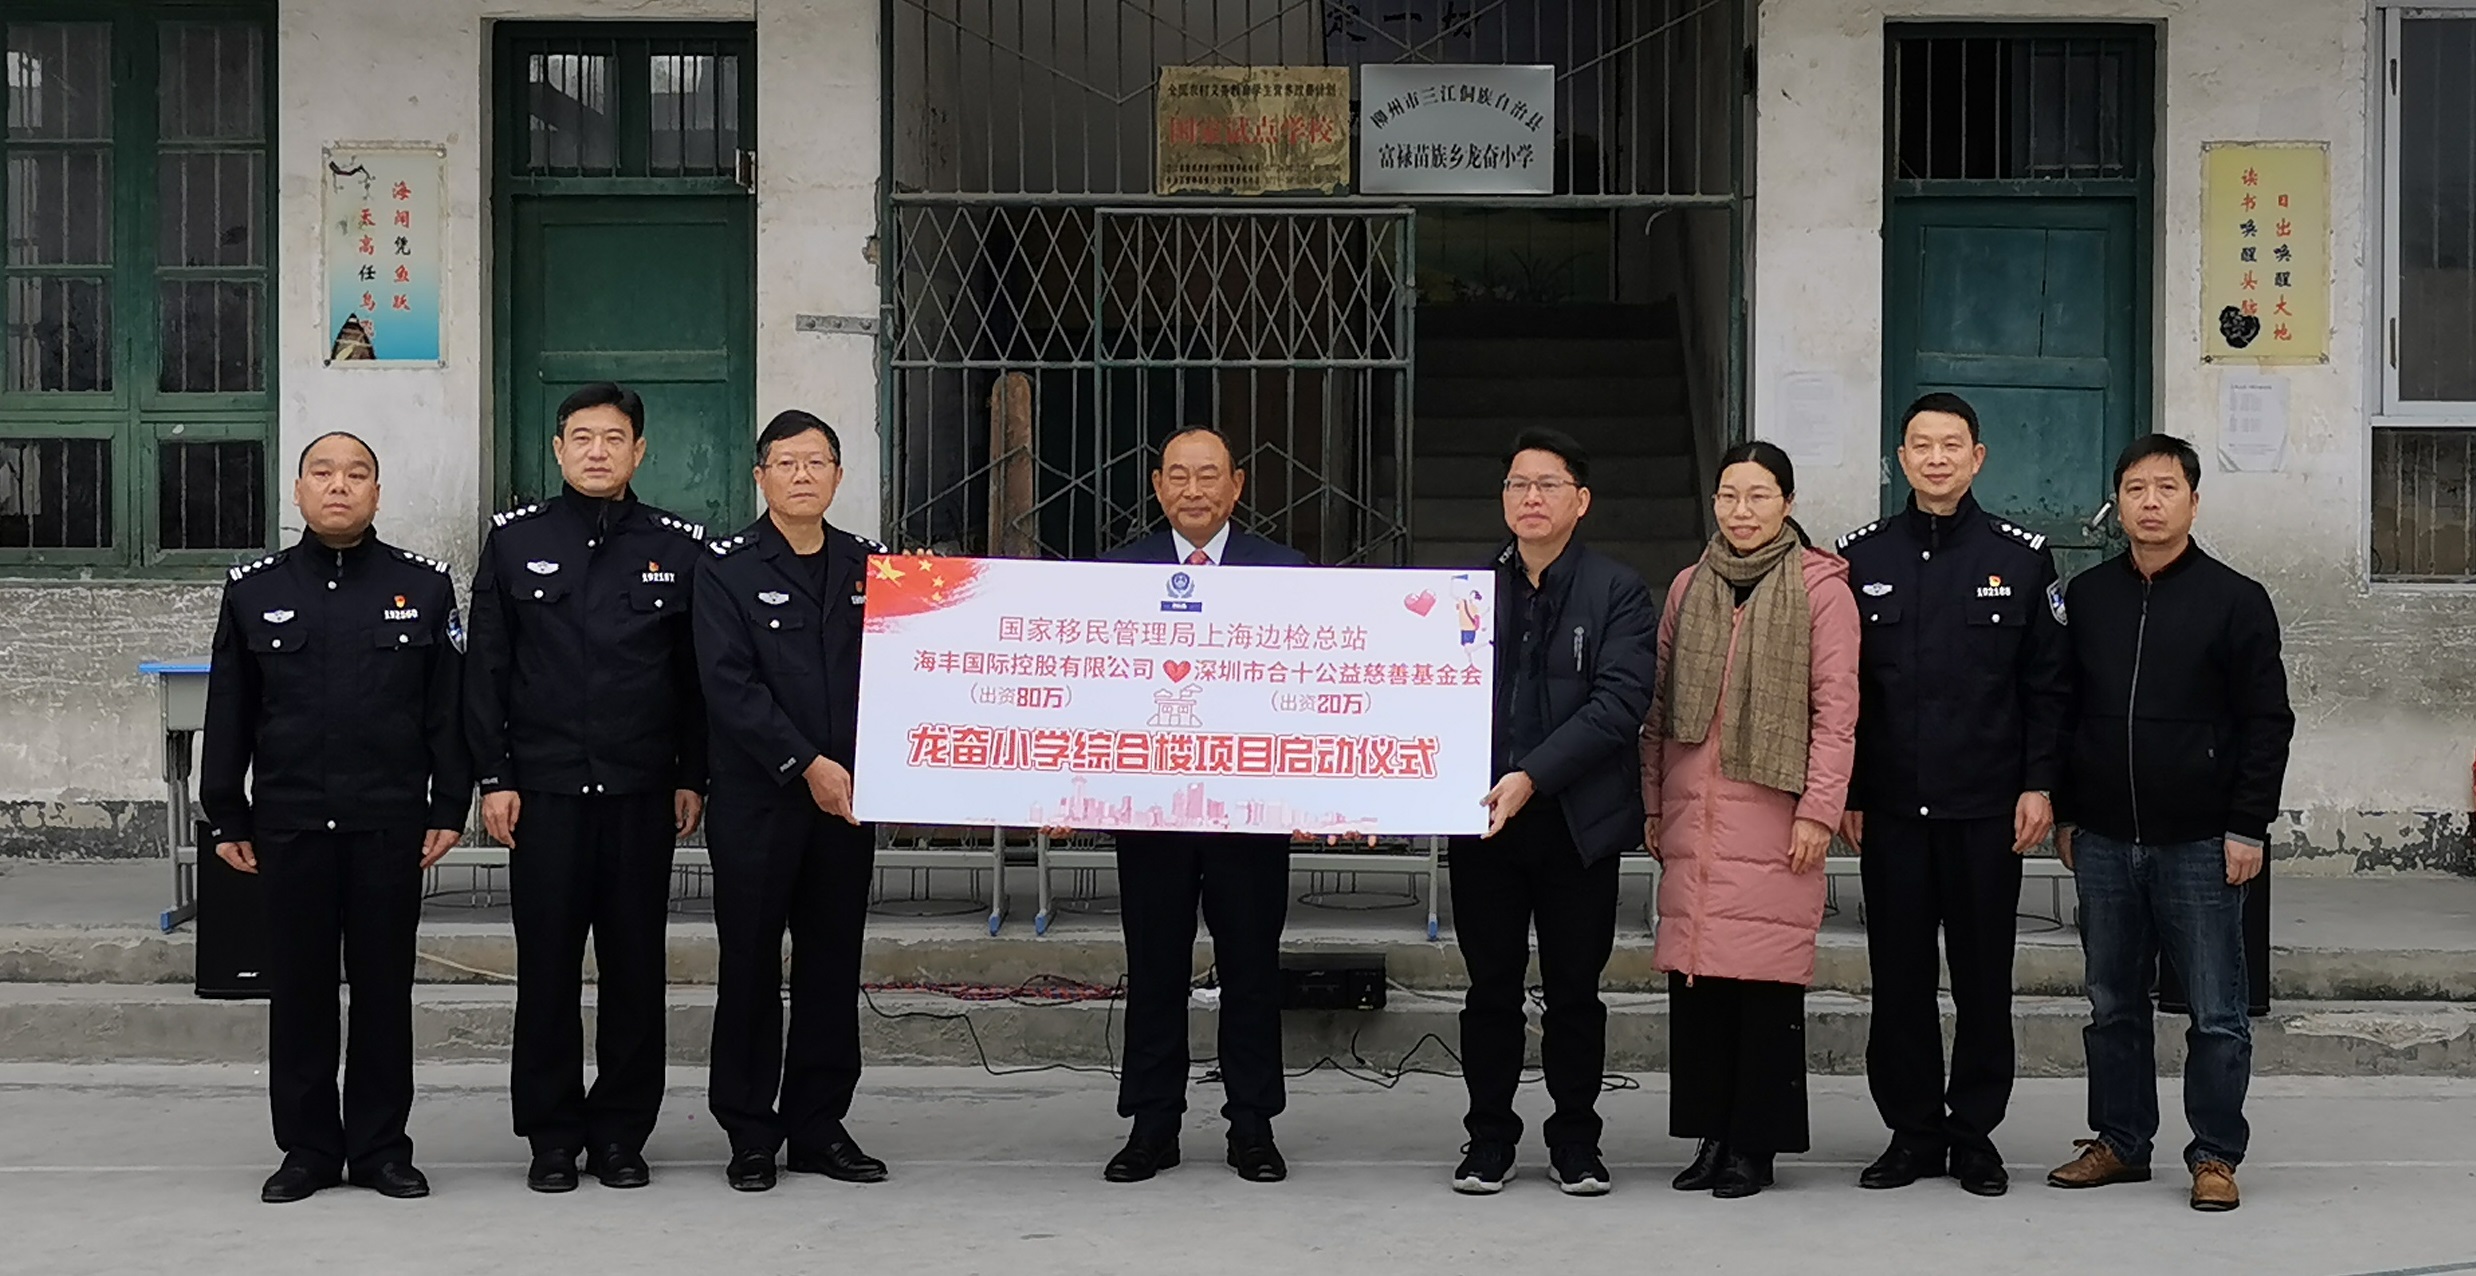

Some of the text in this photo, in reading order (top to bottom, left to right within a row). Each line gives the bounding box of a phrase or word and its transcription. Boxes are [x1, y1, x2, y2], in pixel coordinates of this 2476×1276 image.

[1169, 115, 1334, 145] 国家试点学校
[1369, 84, 1545, 133] 柳州市三江侗族自治县
[1378, 143, 1534, 170] 富禄苗族乡龙奋小学
[391, 180, 412, 312] 海阔凭鱼跃
[2273, 194, 2293, 342] 日出唤醒大地
[999, 616, 1369, 652] 国家移民管理局上海边检总站
[913, 649, 1483, 686] 海丰国际控股有限公司 深圳市合十公益慈善基金会
[907, 723, 1441, 778] 龙奋小学综合楼项目启动仪式
